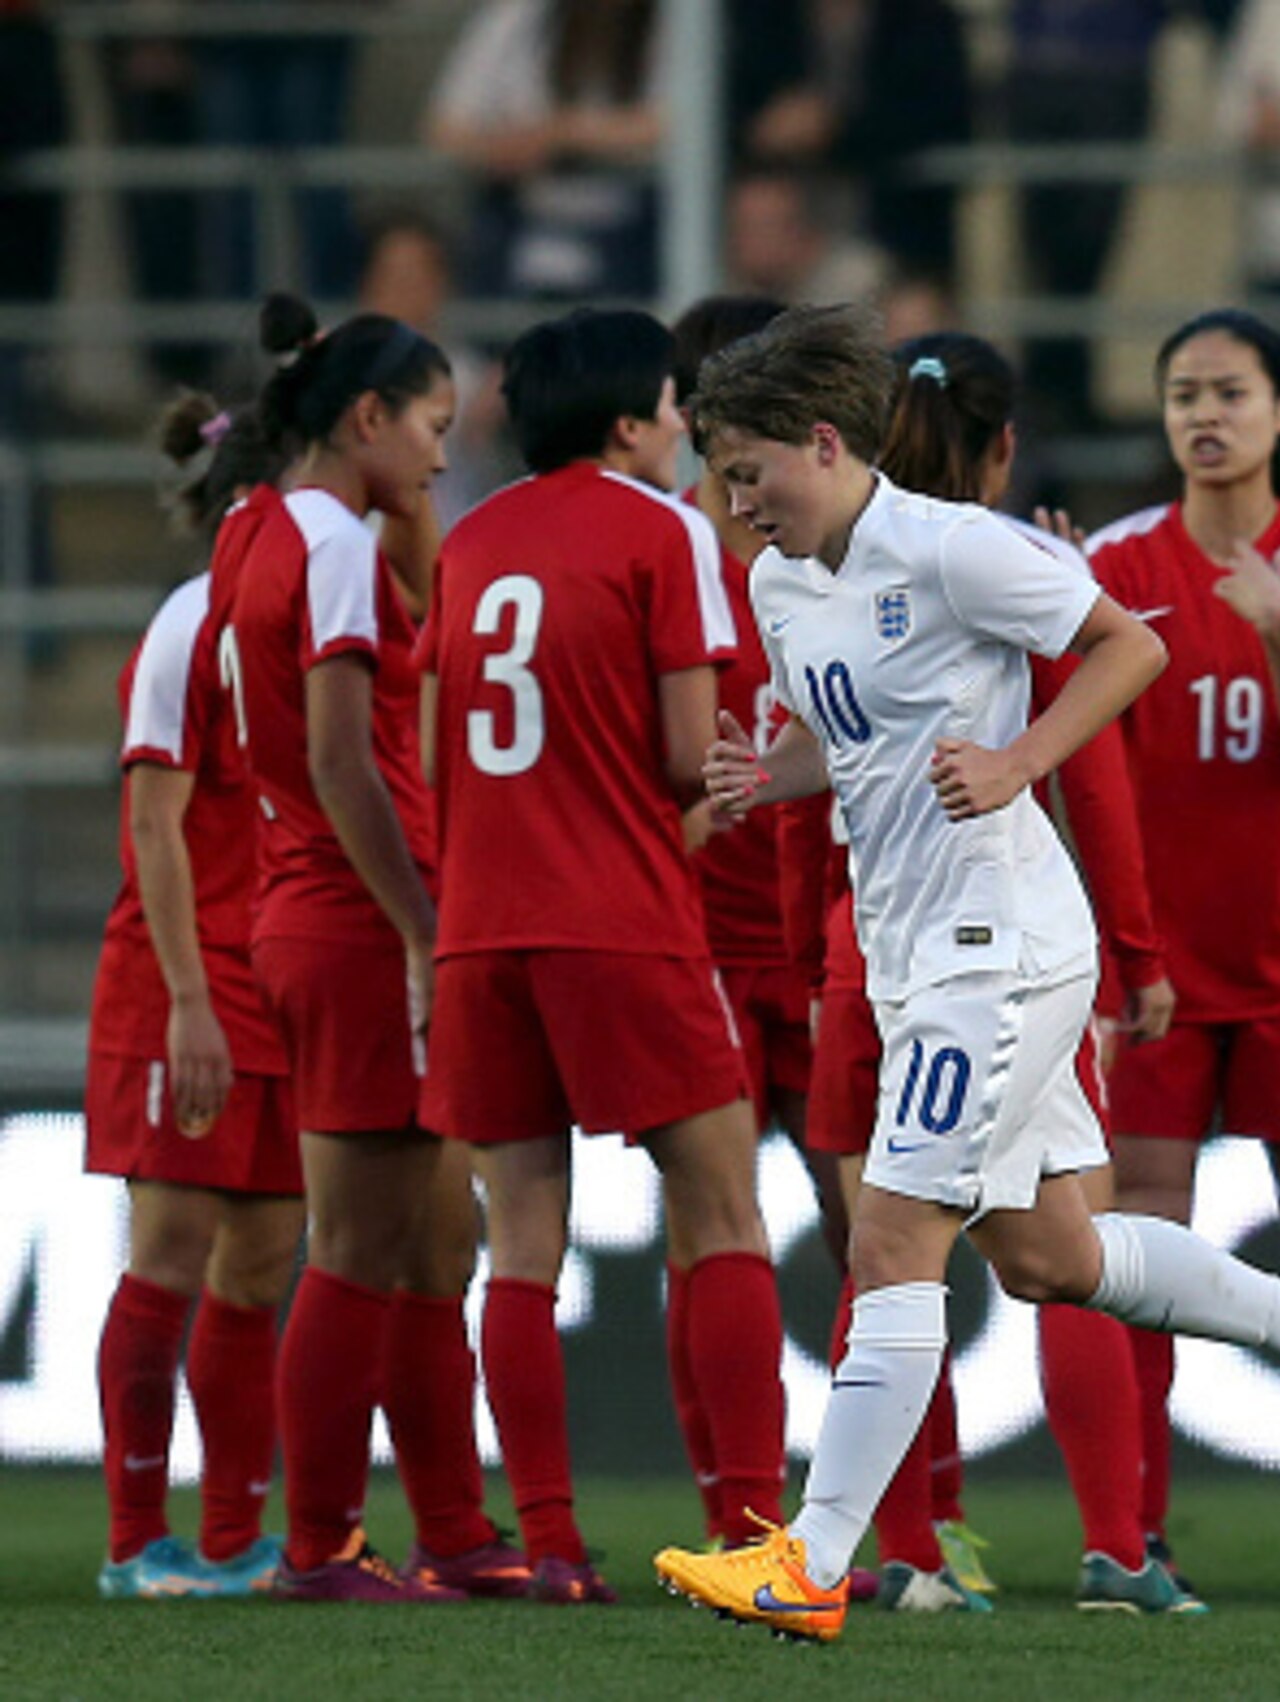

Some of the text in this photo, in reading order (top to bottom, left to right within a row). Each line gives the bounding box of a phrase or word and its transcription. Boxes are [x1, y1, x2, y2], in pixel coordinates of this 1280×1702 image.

[466, 573, 546, 777] 3
[804, 660, 872, 749] 10
[1188, 675, 1263, 763] 19
[897, 1038, 971, 1135] 10
